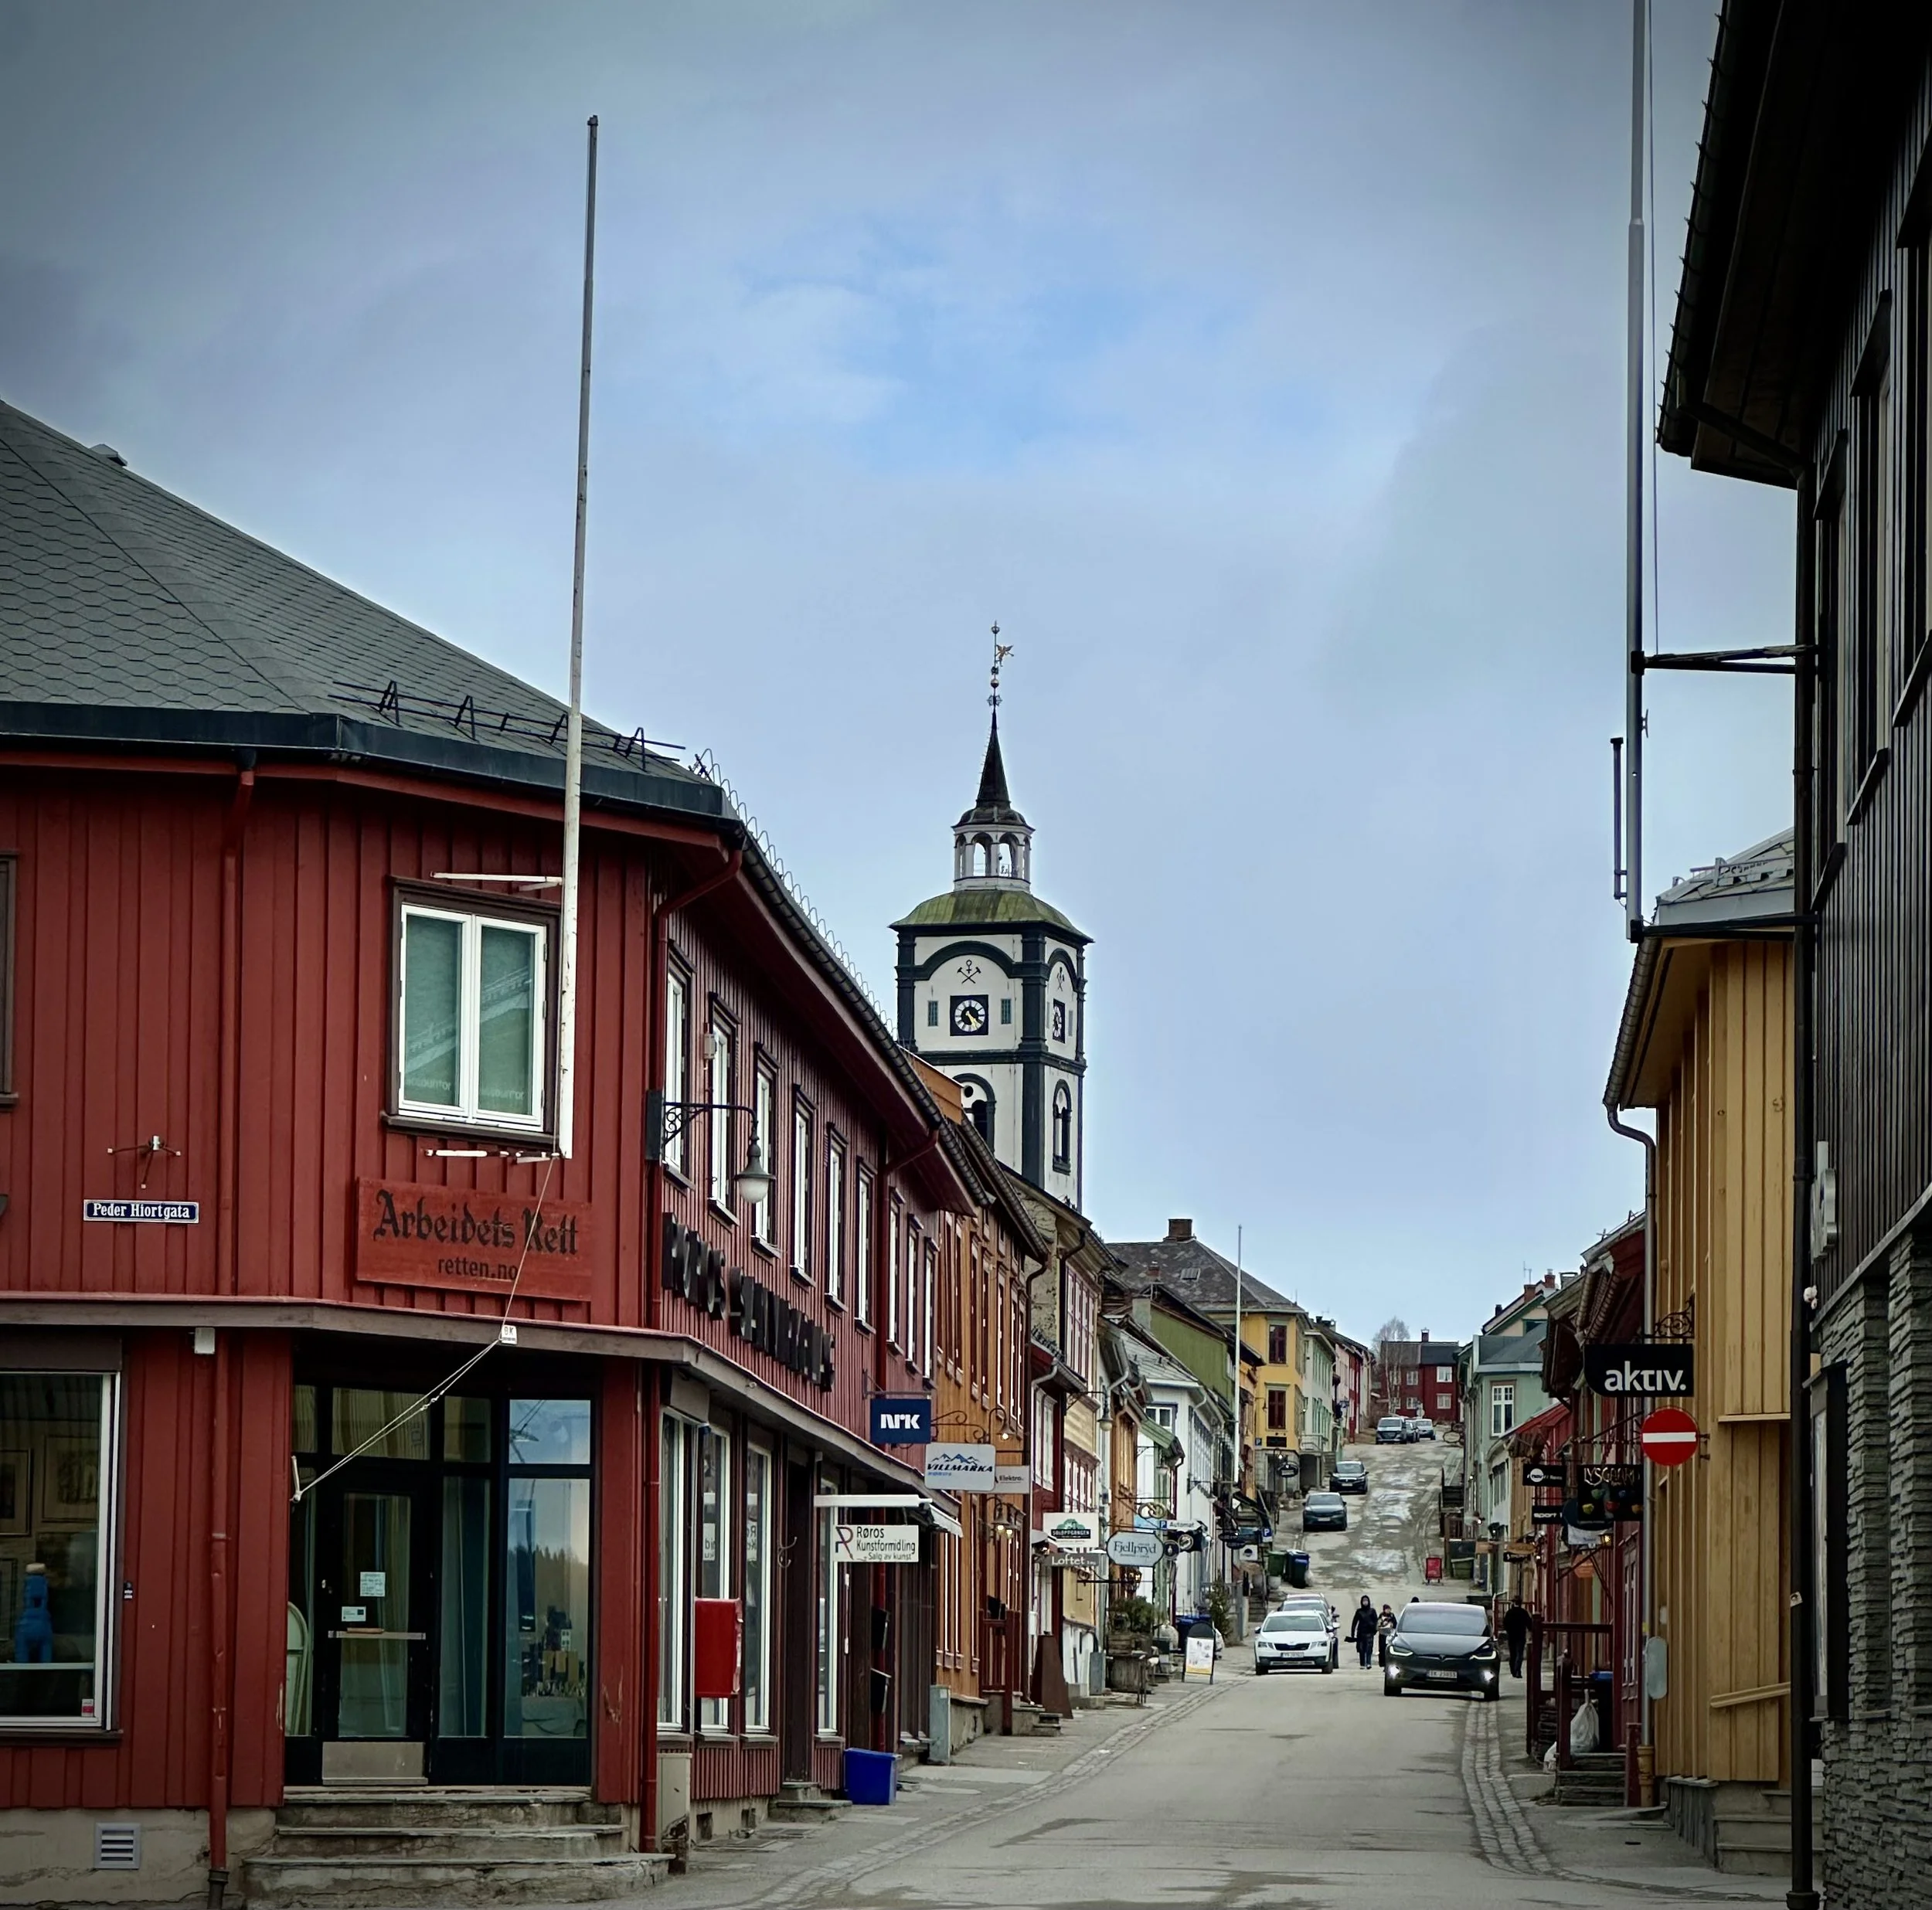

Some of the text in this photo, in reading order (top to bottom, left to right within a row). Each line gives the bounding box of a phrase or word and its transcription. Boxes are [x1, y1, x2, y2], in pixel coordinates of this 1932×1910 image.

[93, 1203, 128, 1217] Peder
[373, 1188, 579, 1256] Arbeidets Rett
[437, 1256, 519, 1280] retten.no
[927, 1463, 993, 1473] VILLMARKA
[856, 1526, 885, 1538] Røros
[856, 1539, 916, 1554] Kunstformidling
[1114, 1541, 1156, 1555] Fjellpryd
[868, 1552, 882, 1561] Salg
[1051, 1553, 1085, 1565] Loftet
